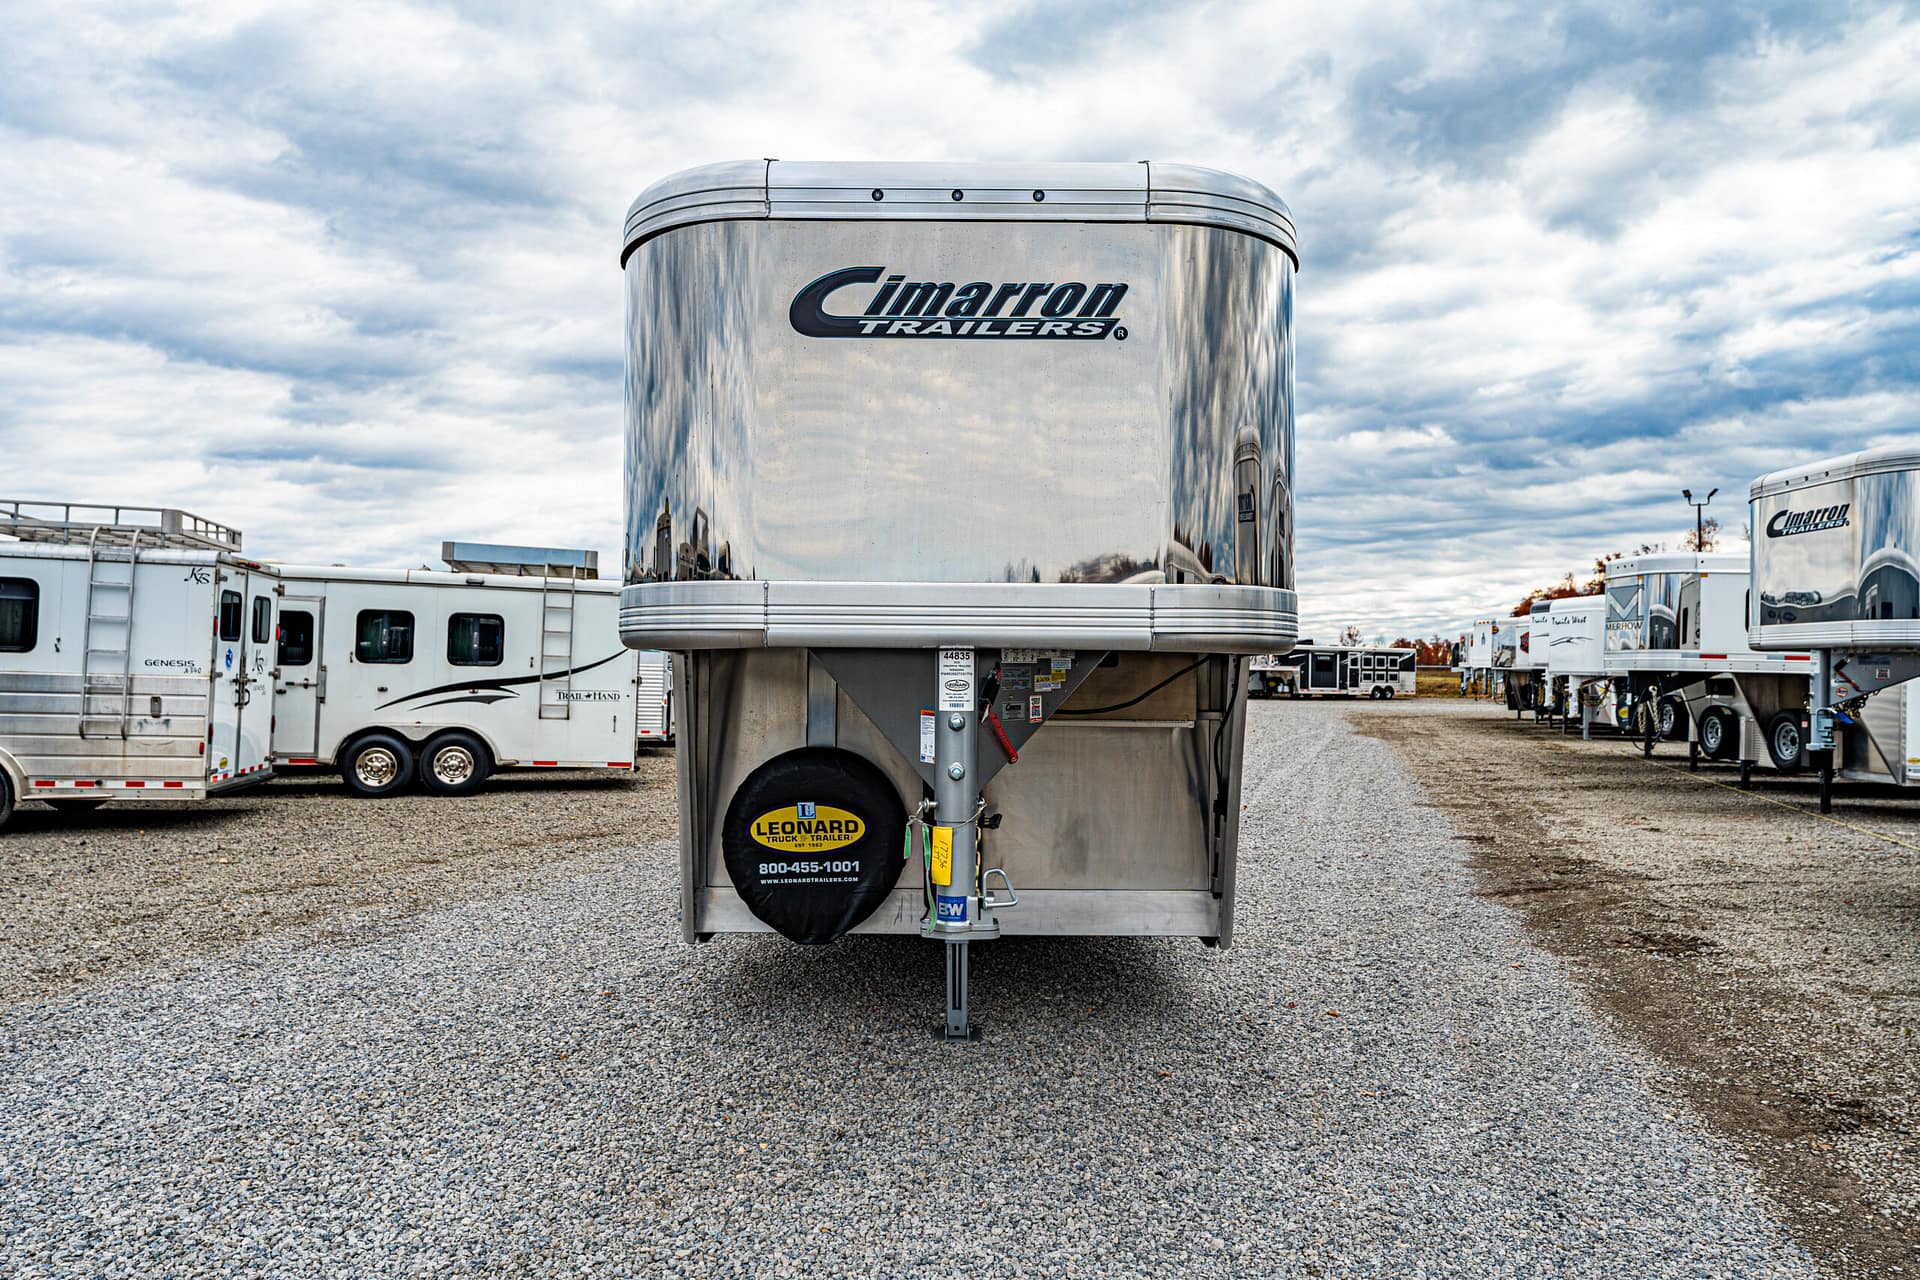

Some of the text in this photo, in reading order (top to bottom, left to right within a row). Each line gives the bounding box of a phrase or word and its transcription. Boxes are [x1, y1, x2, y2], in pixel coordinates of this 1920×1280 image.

[789, 266, 1129, 339] Cimarron
[858, 320, 1105, 335] TRAILERS
[1766, 504, 1850, 538] Cimarron
[1782, 519, 1843, 535] TRAILERS
[1551, 616, 1587, 625] Trails West
[1605, 622, 1643, 630] MERHOW
[943, 652, 970, 660] 44835
[144, 659, 195, 667] GENESIS
[593, 691, 621, 700] HAND
[756, 820, 859, 836] LEONARD
[766, 835, 798, 843] TRUCK
[811, 834, 850, 842] TRAILER
[759, 861, 860, 875] 800-455-1001
[760, 877, 859, 885] WWW.LEONARDTRAILERS.COM
